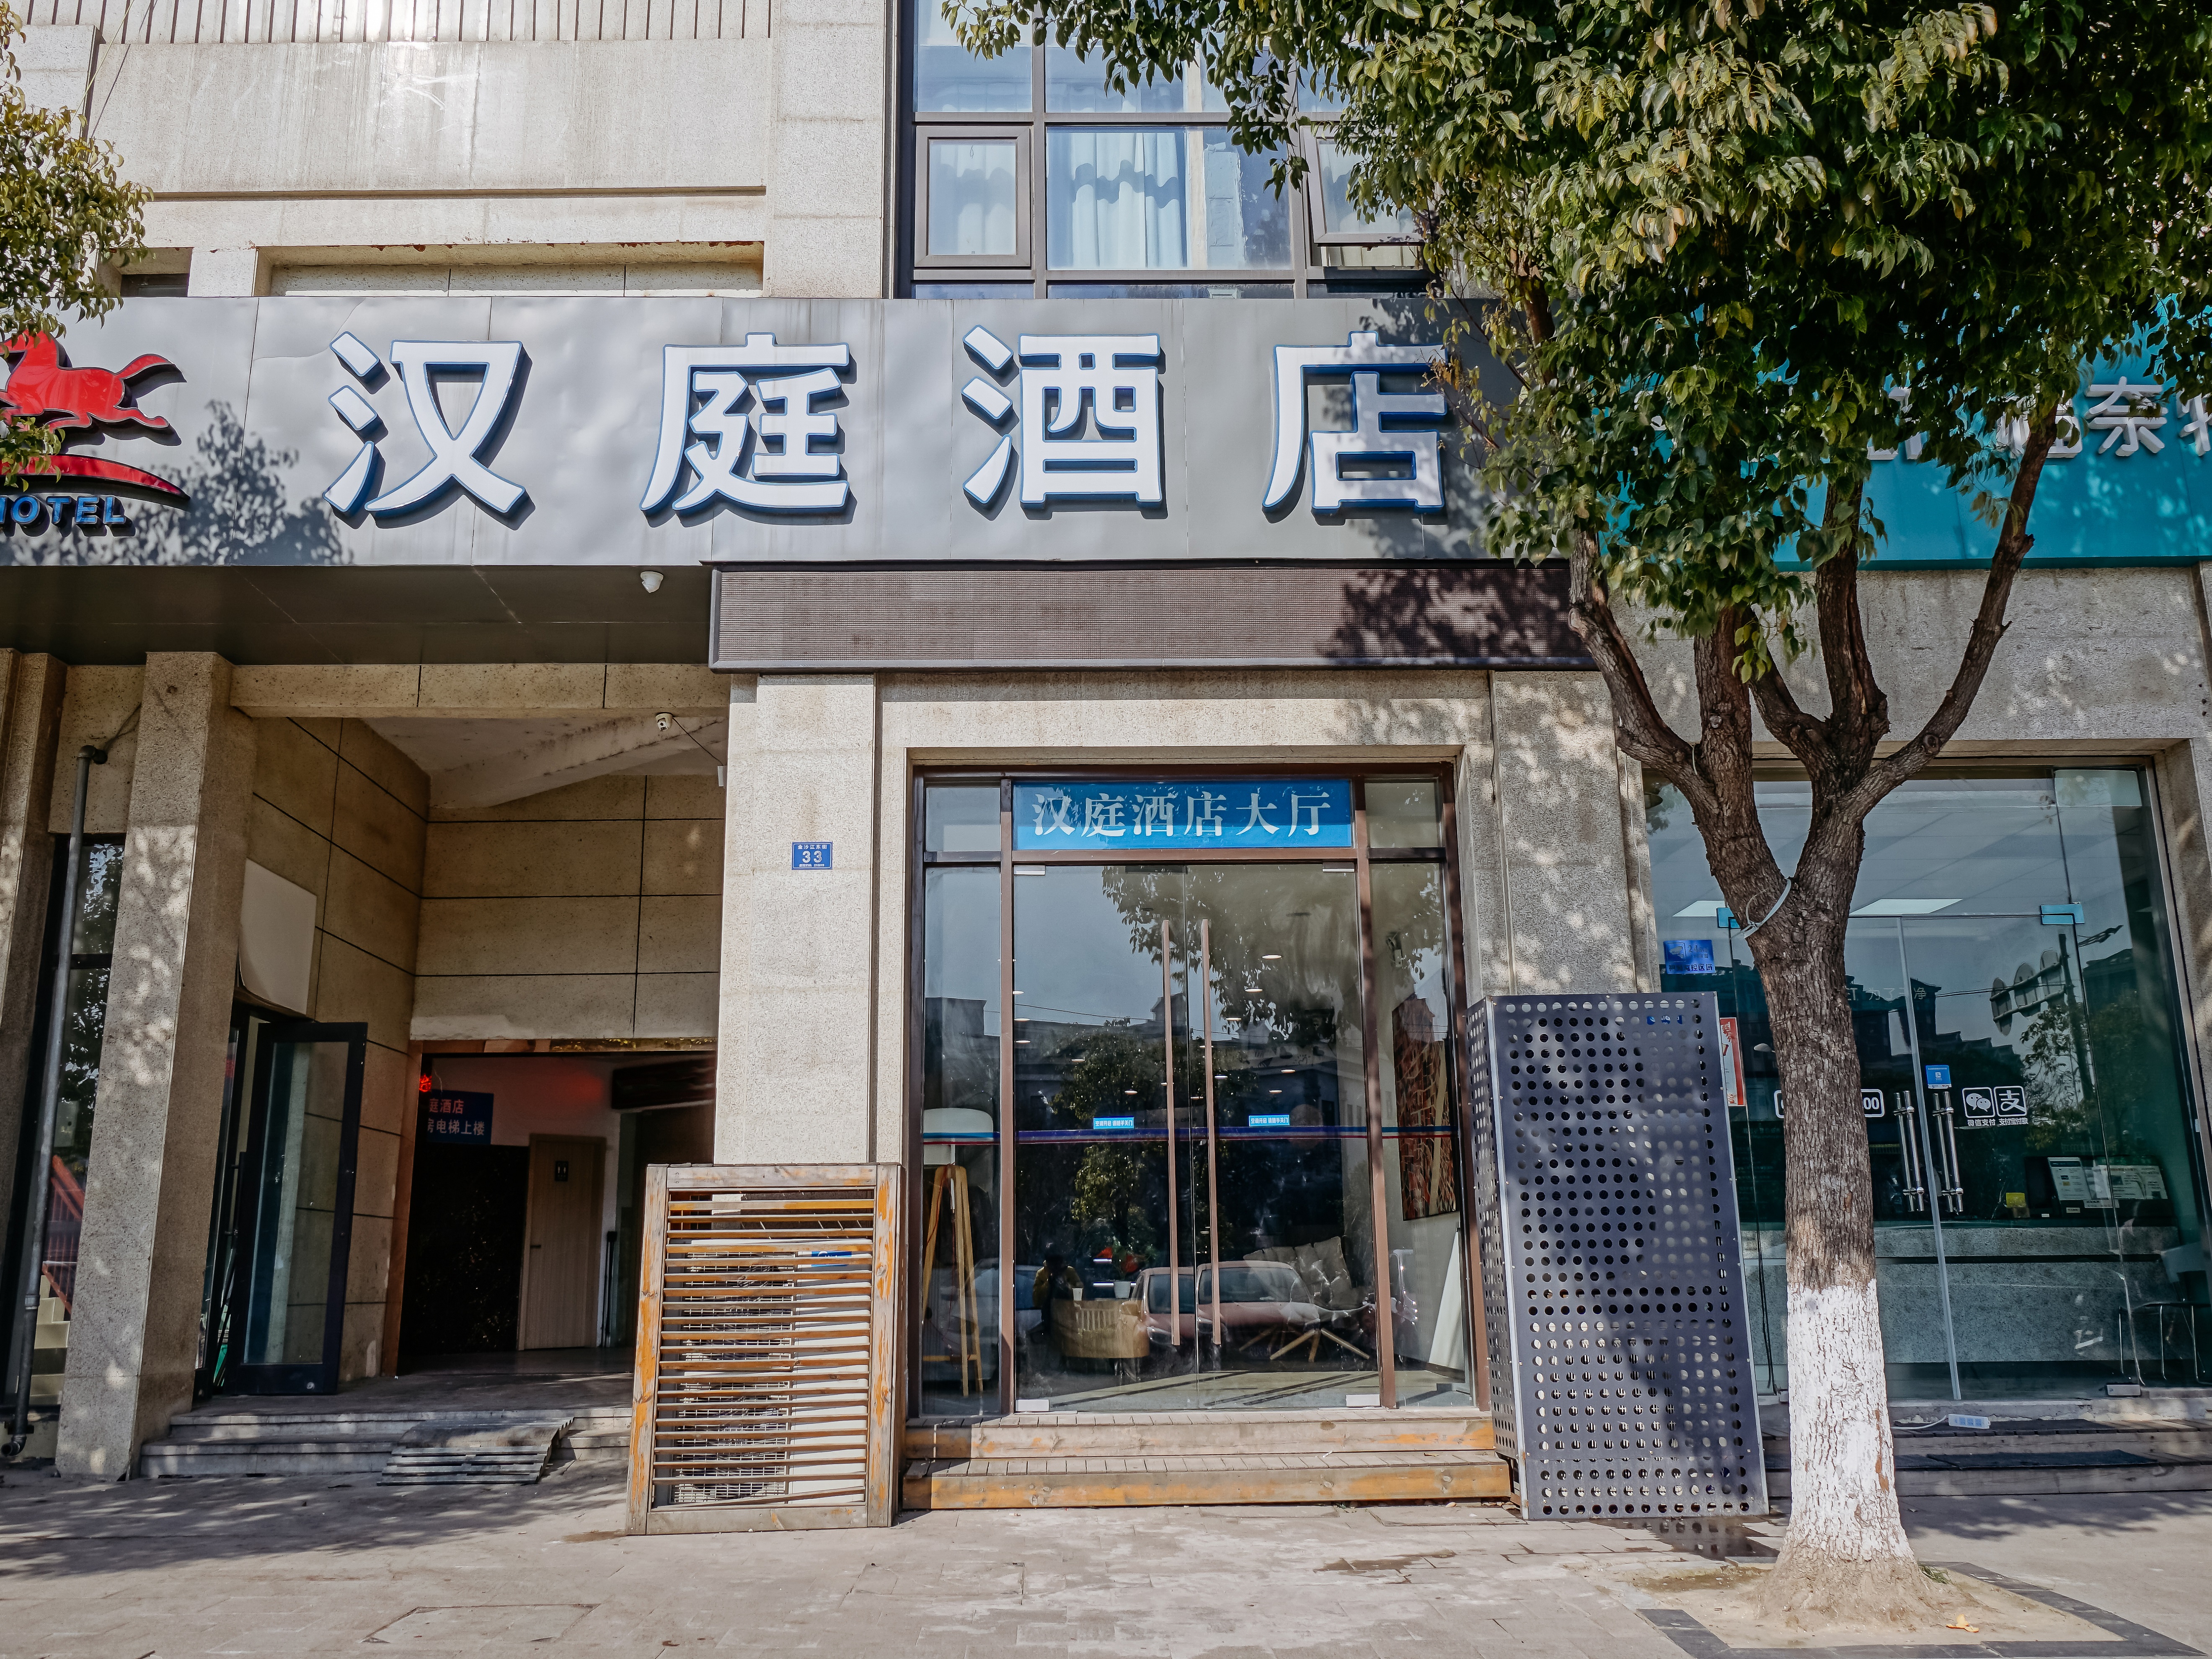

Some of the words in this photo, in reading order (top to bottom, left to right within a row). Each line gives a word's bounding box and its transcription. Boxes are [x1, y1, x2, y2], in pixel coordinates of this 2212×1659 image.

[322, 325, 1448, 514] 汉庭酒店
[0, 495, 126, 524] OTEL
[1032, 791, 1331, 837] 汉庭酒店大厅
[802, 850, 822, 863] 33
[1998, 1117, 2029, 1126] 支付宝付款
